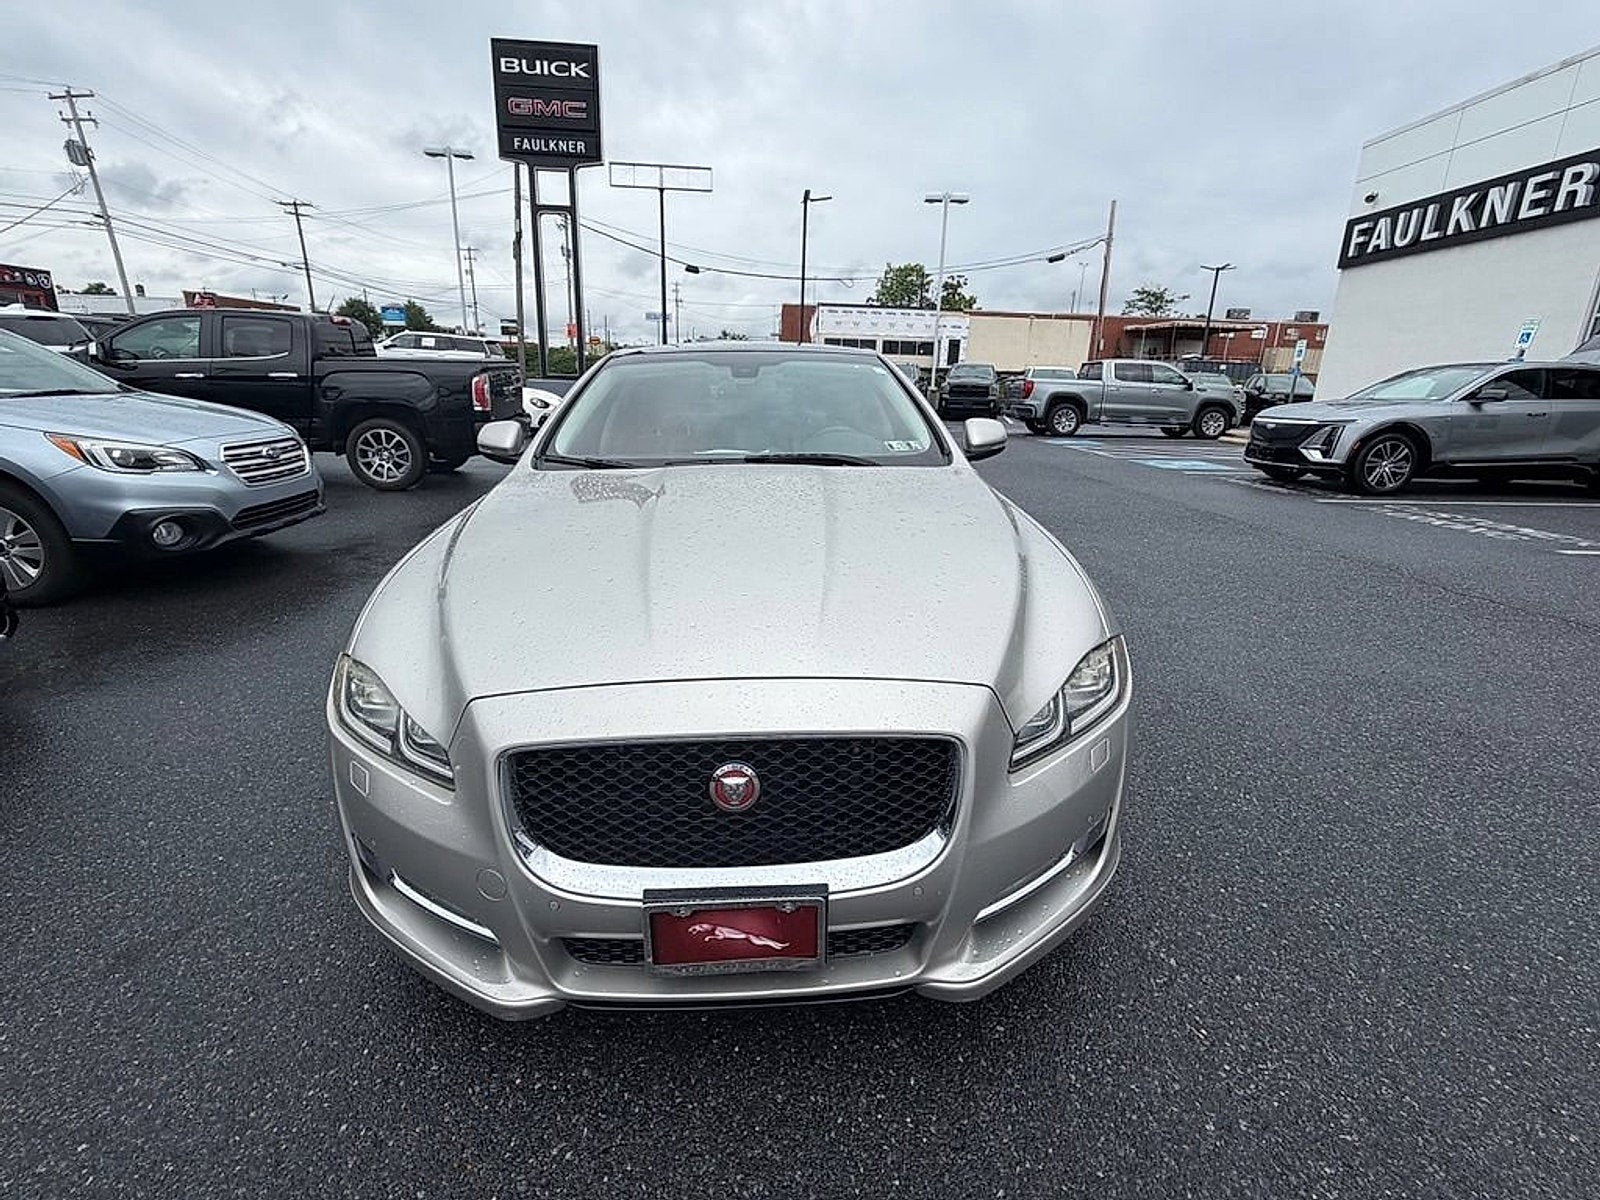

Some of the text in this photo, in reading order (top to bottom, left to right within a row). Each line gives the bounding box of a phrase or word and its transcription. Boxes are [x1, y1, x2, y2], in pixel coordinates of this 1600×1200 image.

[500, 57, 591, 78] BUICK
[507, 97, 587, 118] GMC
[513, 137, 586, 154] FAULKNER
[1347, 162, 1600, 258] FAULKNER
